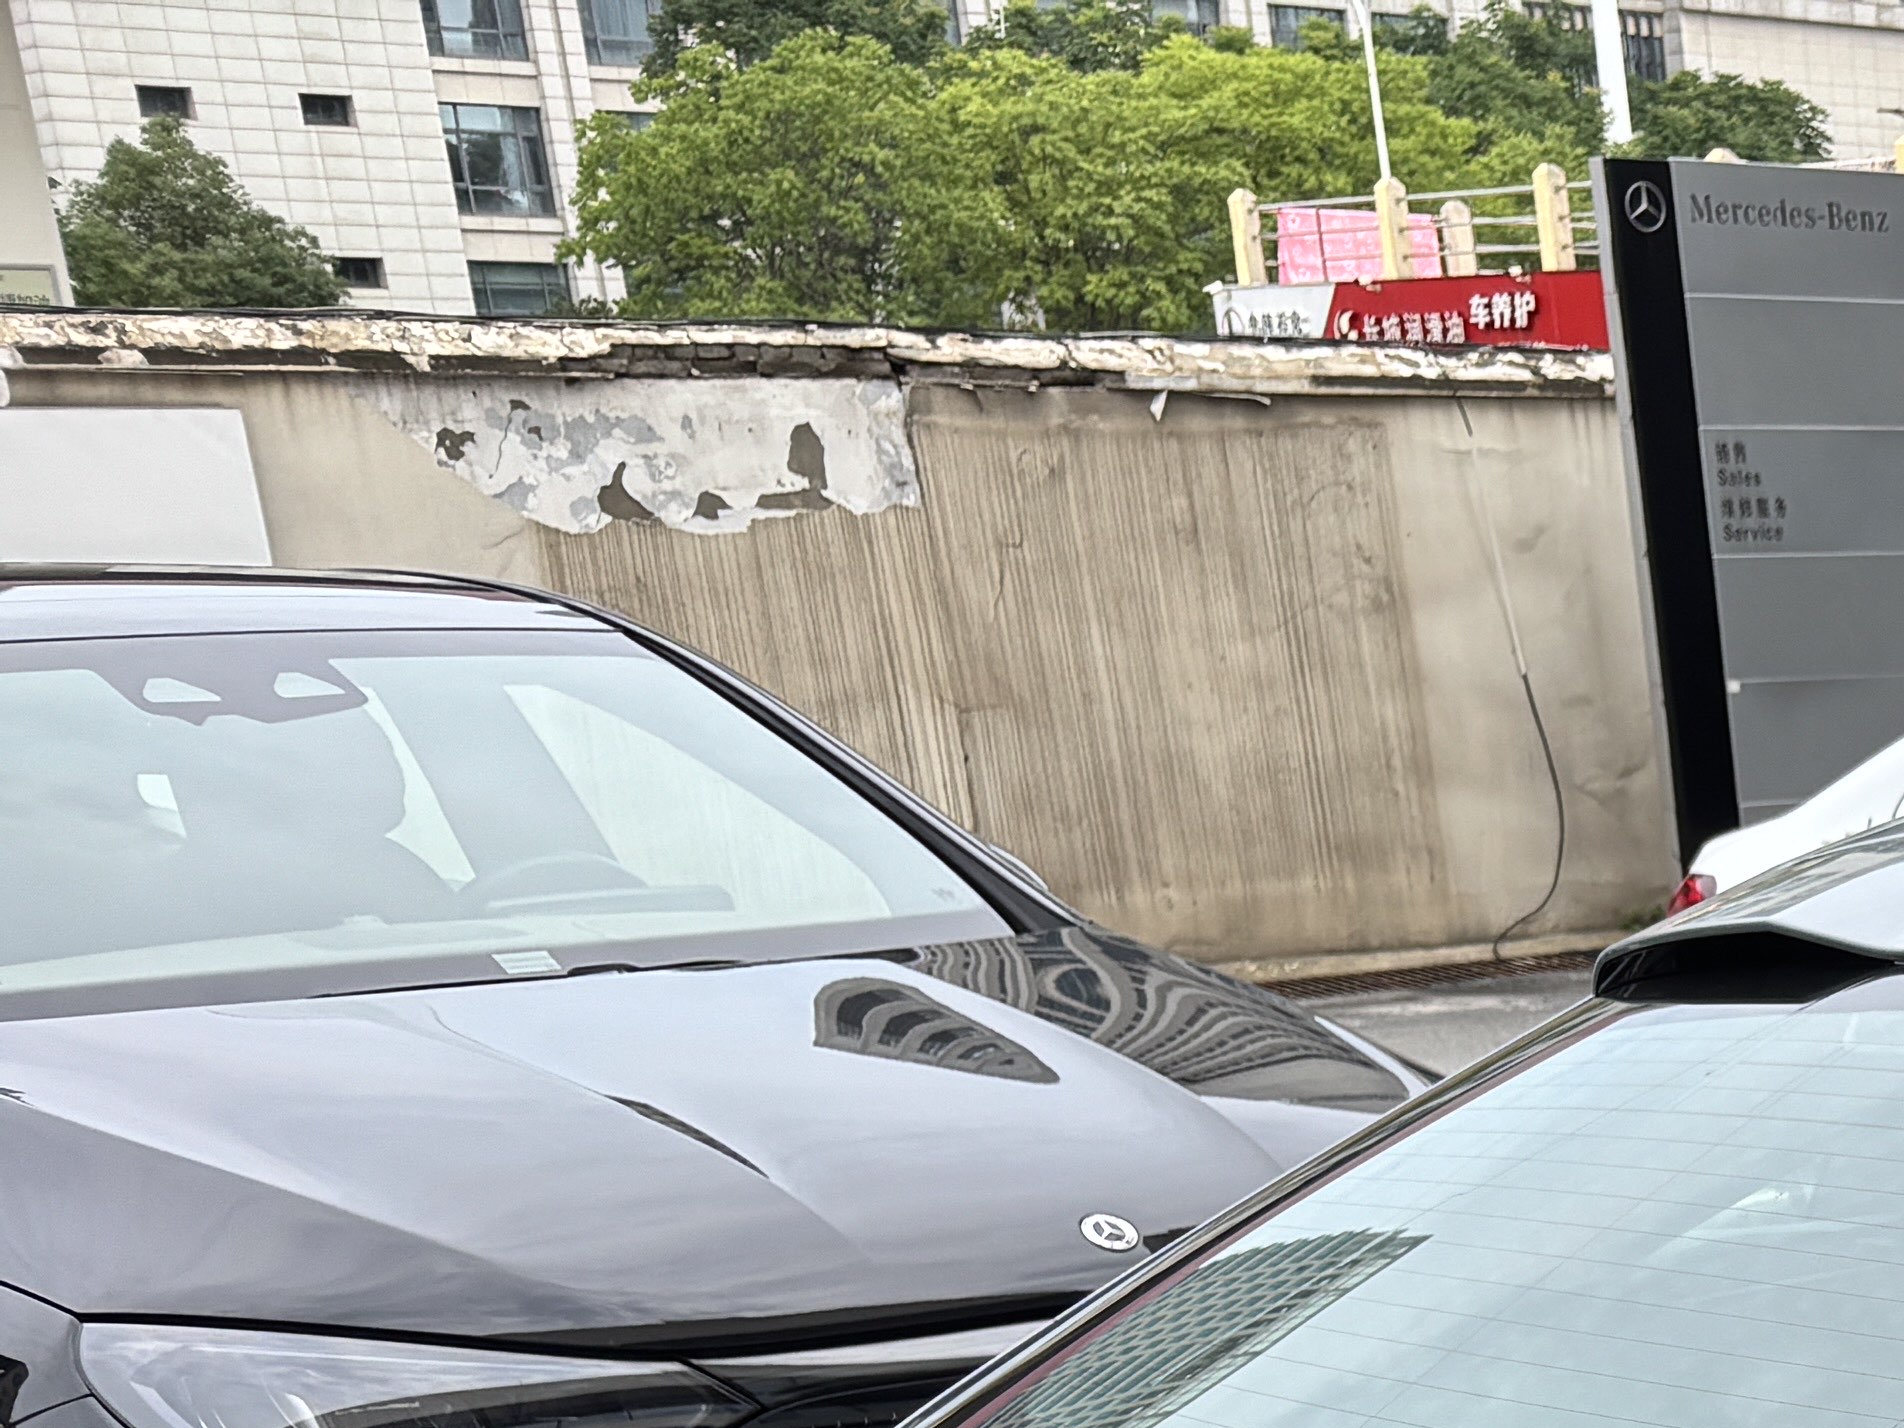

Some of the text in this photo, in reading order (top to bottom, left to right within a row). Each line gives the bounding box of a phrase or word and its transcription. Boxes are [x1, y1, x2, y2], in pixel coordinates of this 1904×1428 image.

[1690, 192, 1890, 233] Mercedes-Benz
[1468, 290, 1536, 331] 车养护
[1723, 523, 1784, 542] Service
